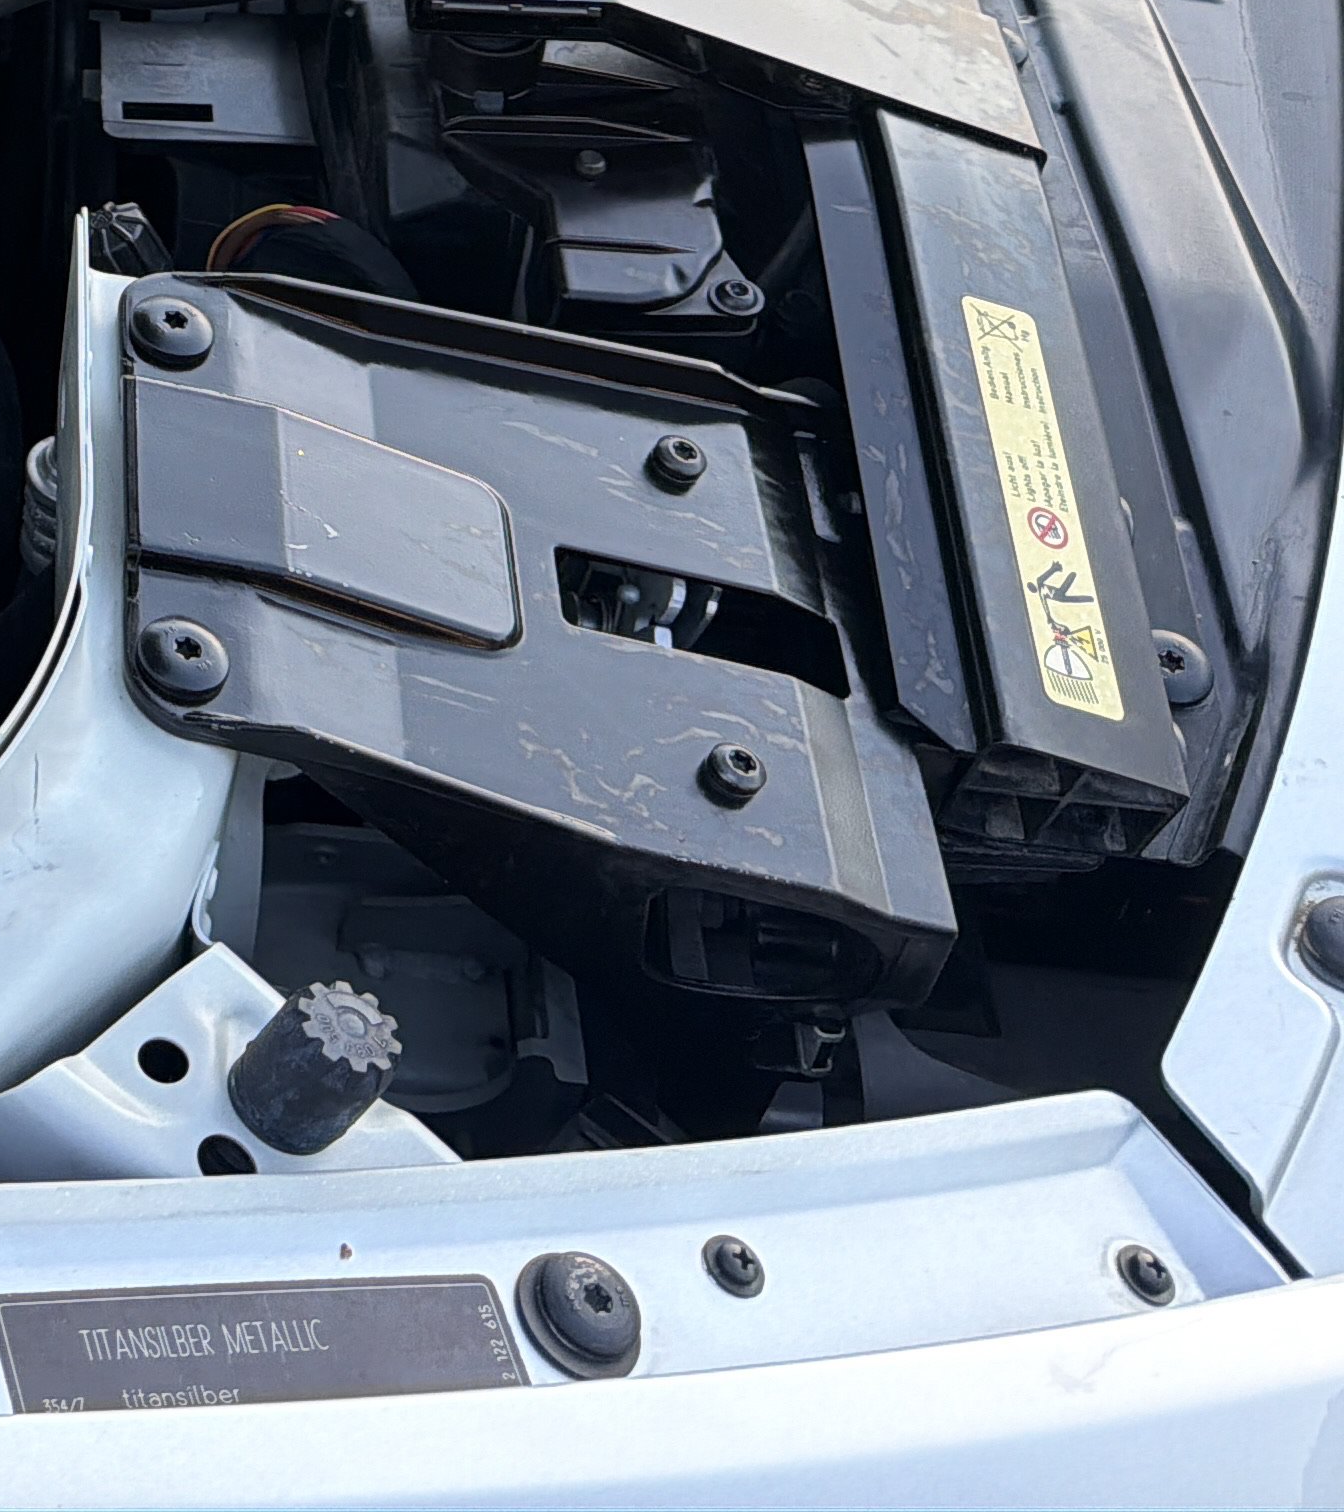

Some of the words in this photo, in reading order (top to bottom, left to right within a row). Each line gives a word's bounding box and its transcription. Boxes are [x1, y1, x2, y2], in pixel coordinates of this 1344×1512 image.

[1000, 371, 1014, 404] Manual
[1029, 368, 1047, 413] Instruction
[1007, 475, 1021, 497] Licht
[1023, 475, 1036, 501] Lights
[477, 1304, 498, 1330] 615
[79, 1324, 215, 1362] TITANSILBER
[223, 1317, 331, 1356] METALLIC
[491, 1339, 508, 1361] 122
[502, 1371, 515, 1381] 2
[122, 1383, 241, 1410] titansilber
